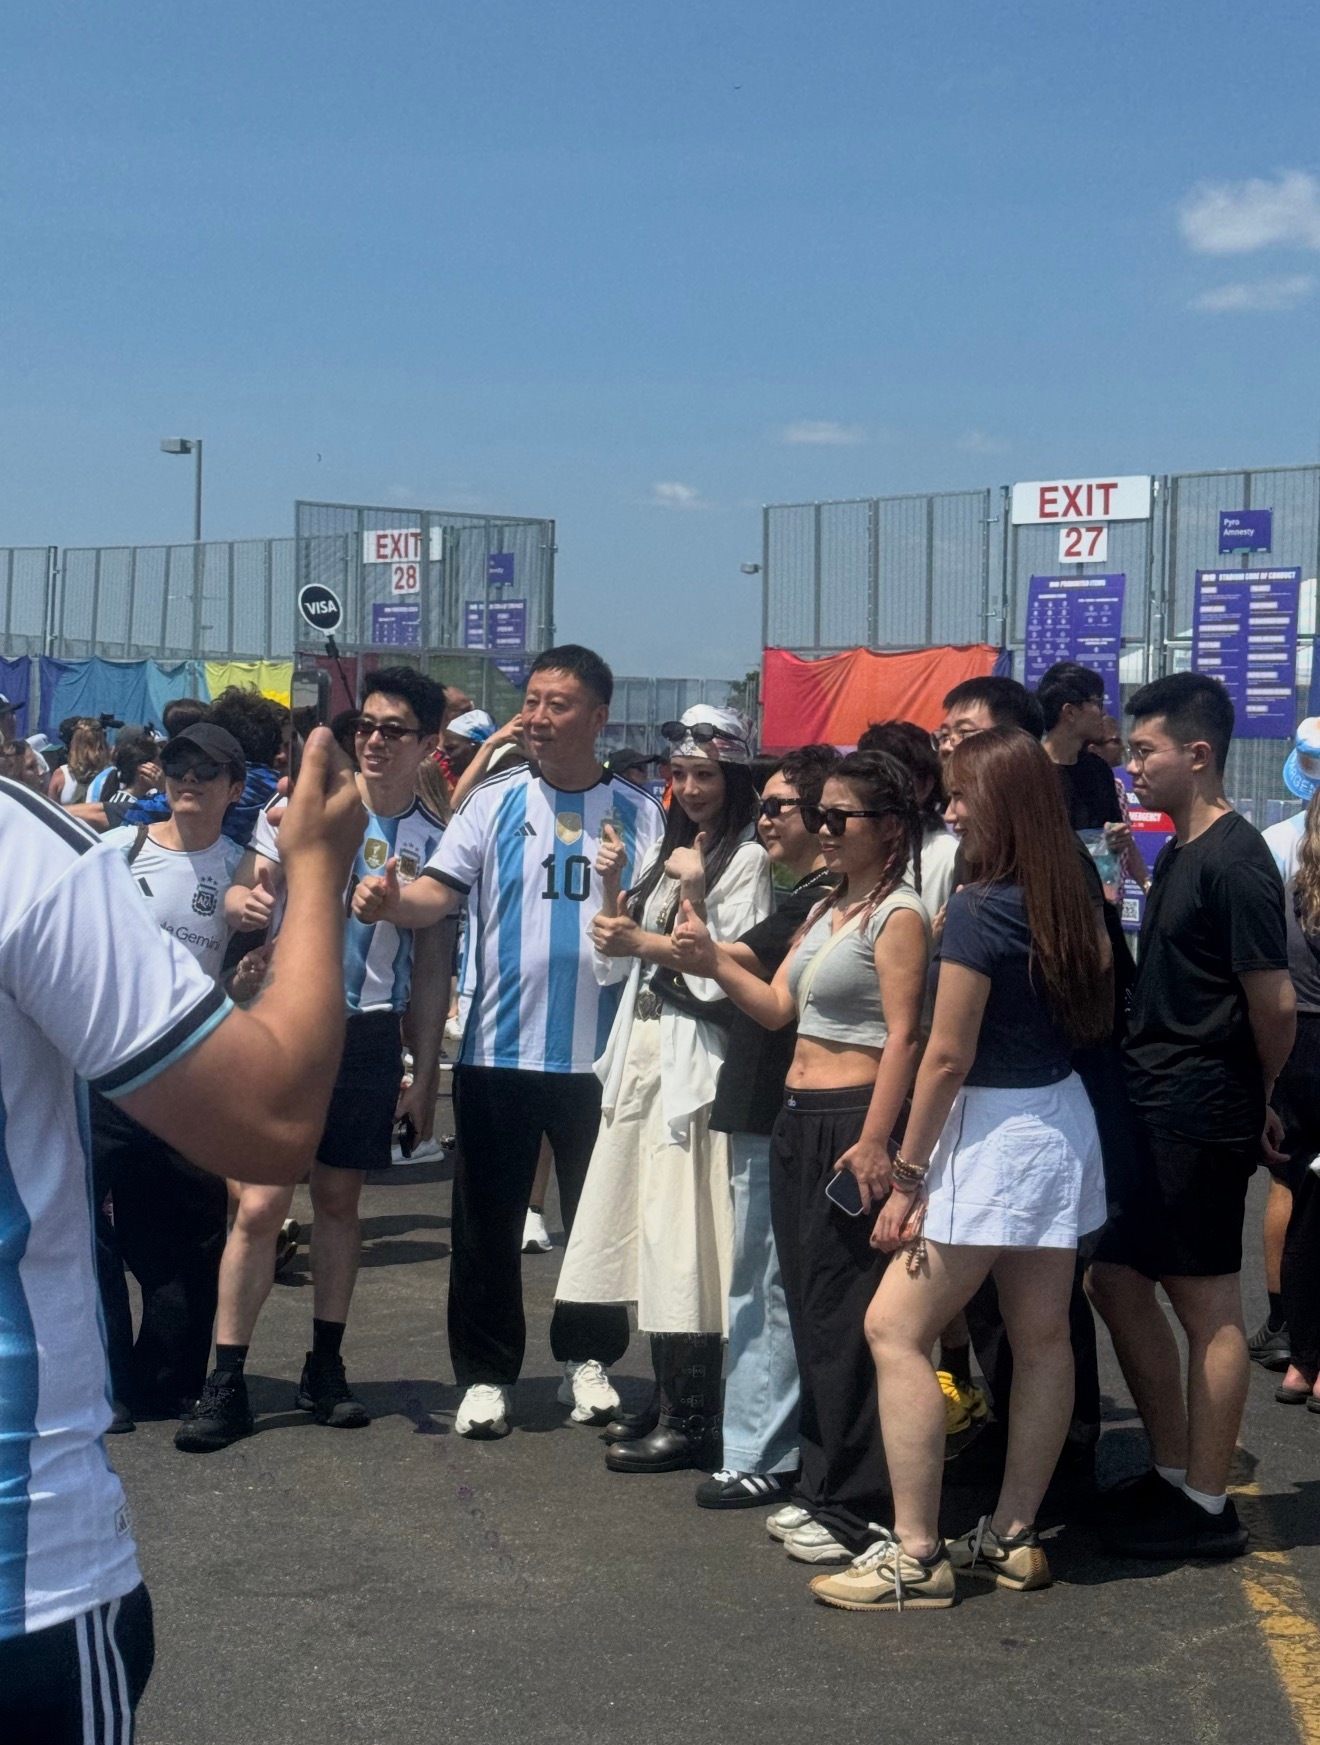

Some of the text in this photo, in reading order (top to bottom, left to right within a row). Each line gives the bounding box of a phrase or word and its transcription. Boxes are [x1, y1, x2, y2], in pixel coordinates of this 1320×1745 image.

[1039, 483, 1118, 518] EXIT
[1223, 518, 1240, 528] Pyro
[1223, 528, 1255, 537] Amnesty
[376, 532, 422, 559] EXIT
[1064, 526, 1104, 557] 27
[394, 564, 417, 590] 28
[304, 600, 337, 615] VISA
[541, 854, 591, 901] 10
[176, 926, 221, 951] Gemini
